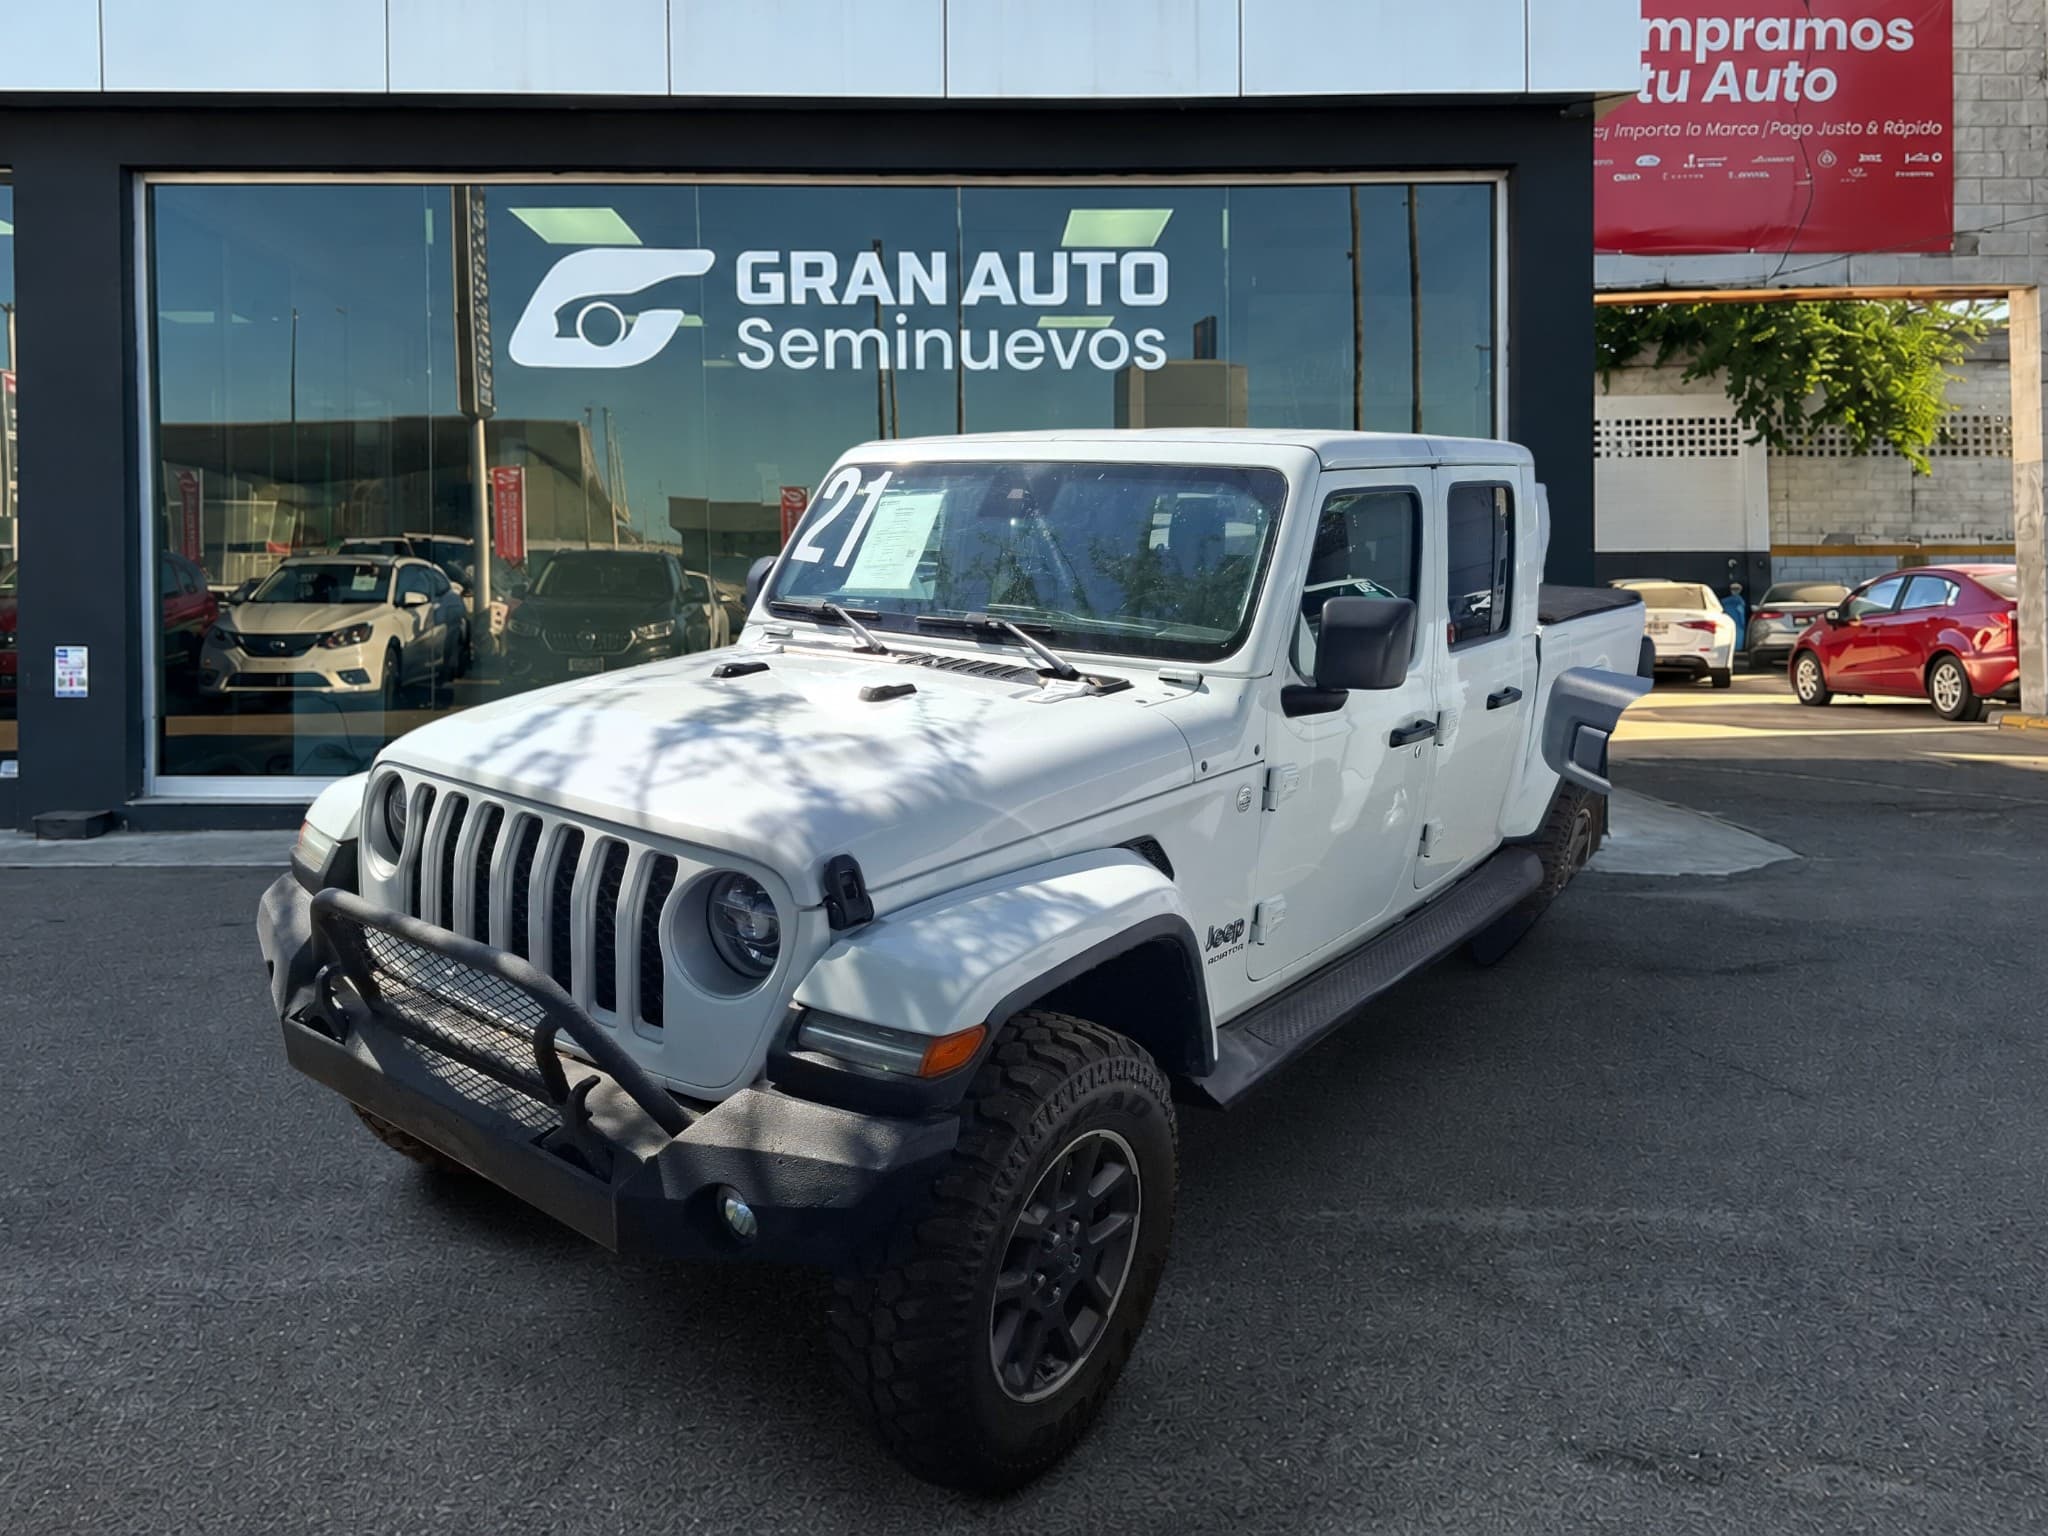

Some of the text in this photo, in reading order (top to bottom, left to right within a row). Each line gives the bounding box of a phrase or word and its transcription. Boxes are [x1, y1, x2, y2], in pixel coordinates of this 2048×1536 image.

[1641, 17, 1915, 64] mpramos
[1637, 60, 1838, 104] tu Auto
[1614, 123, 1681, 141] Importa
[1705, 122, 1760, 137] Marca
[1816, 121, 1863, 137] Justo
[1866, 120, 1879, 136] &
[1883, 118, 1943, 140] Rápido
[736, 251, 1169, 306] GRAN AUTO
[737, 313, 1168, 370] Seminuevos
[791, 467, 893, 567] 21
[1204, 918, 1245, 952] Jeep
